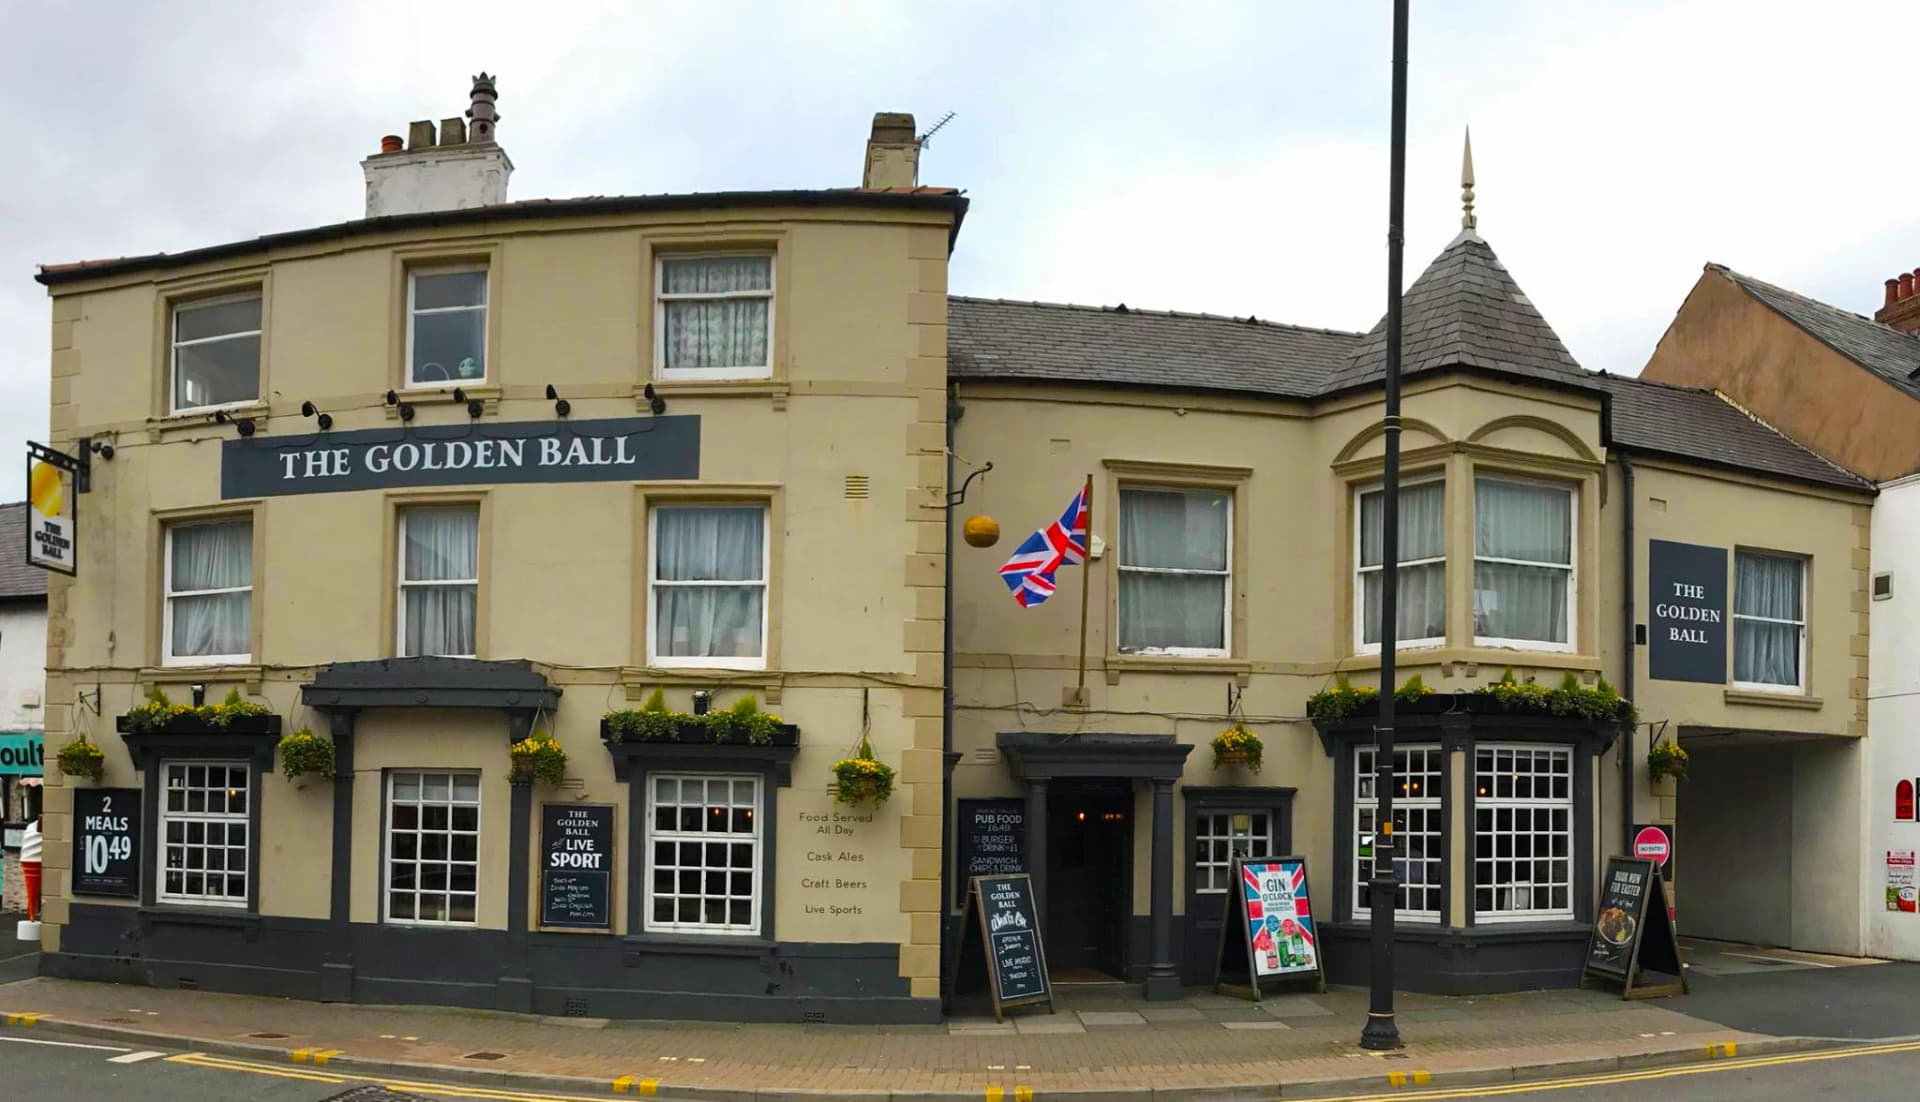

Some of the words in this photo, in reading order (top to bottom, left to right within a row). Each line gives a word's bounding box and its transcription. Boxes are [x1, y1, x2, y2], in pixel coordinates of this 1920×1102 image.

[280, 448, 351, 479] THE
[364, 438, 527, 473] GOLDEN
[538, 435, 636, 468] BALL
[44, 521, 62, 536] THE
[35, 530, 70, 550] GOLDEN
[42, 543, 64, 560] BALL
[1673, 582, 1704, 599] THE
[1656, 603, 1720, 623] GOLDEN
[1669, 627, 1708, 644] BALL
[102, 796, 112, 813] 2
[568, 810, 588, 818] THE
[799, 812, 829, 822] Food
[832, 812, 873, 823] Served
[975, 814, 996, 824] PUB
[996, 814, 1022, 824] FOOD
[85, 816, 128, 832] MEALS
[557, 818, 599, 828] GOLDEN
[565, 828, 590, 836] BALL
[816, 825, 831, 835] All
[834, 825, 854, 837] Day
[566, 839, 595, 851] LIVE
[550, 852, 603, 869] SPORT
[807, 851, 833, 862] Cask
[838, 851, 864, 862] Ales
[971, 856, 1018, 865] SANDWICH
[801, 878, 830, 889] Craft
[835, 878, 867, 889] Beers
[996, 883, 1012, 892] THE
[1266, 878, 1286, 892] GIN
[990, 891, 1021, 901] GOLDEN
[1620, 883, 1641, 897] EASTER
[1262, 892, 1293, 903] O'CLOCK
[805, 903, 825, 914] Live
[830, 904, 862, 917] Sports
[998, 900, 1017, 909] BALL
